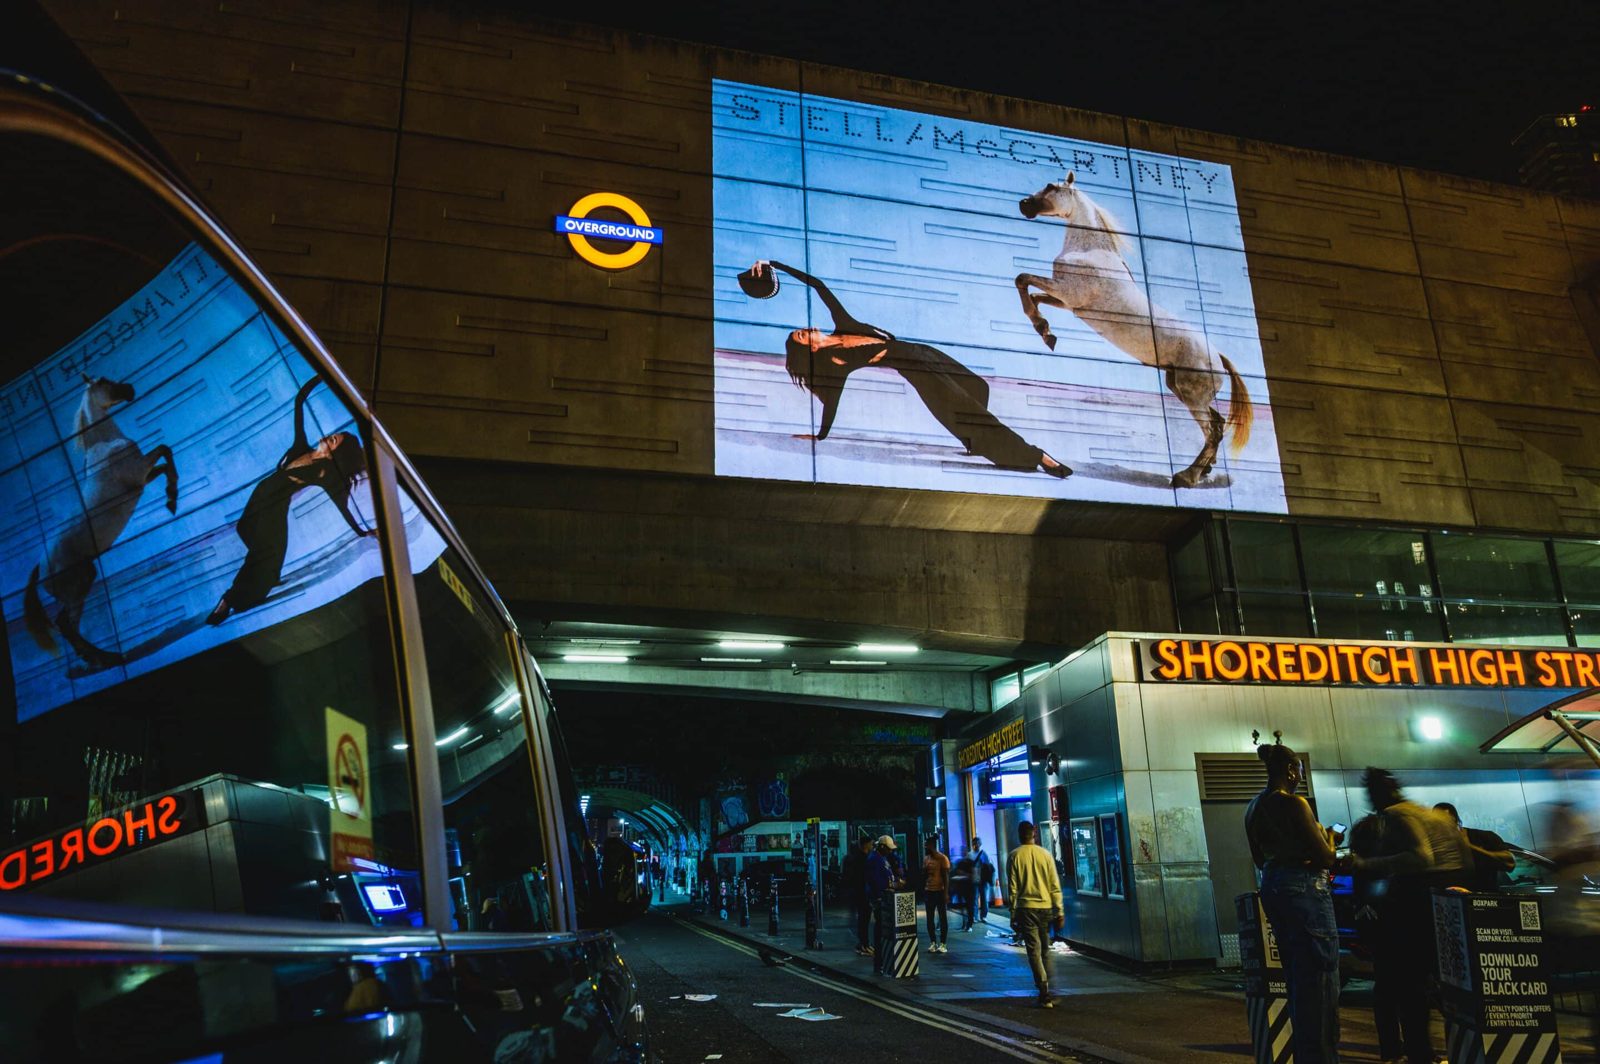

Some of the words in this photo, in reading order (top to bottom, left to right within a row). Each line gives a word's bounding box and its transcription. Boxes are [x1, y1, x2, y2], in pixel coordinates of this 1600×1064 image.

[564, 219, 655, 240] OVERGROUND
[1157, 638, 1420, 685] SHOREDITCH
[1429, 648, 1526, 686] HIGH
[1001, 719, 1025, 751] STREET
[1472, 899, 1498, 908] BOXPARK
[1475, 928, 1491, 936] SCAN
[1479, 953, 1539, 968] DOWNLOAD
[1481, 967, 1513, 981] YOUR
[1482, 981, 1520, 996] BLACK
[1520, 982, 1548, 996] CARD
[1488, 1005, 1511, 1013] LOYALTY
[1511, 1005, 1529, 1013] POINTS
[1534, 1005, 1552, 1013] OFFERS
[1489, 1012, 1510, 1020] EVENTS
[1490, 1019, 1508, 1027] ENTRY
[1508, 1019, 1515, 1027] TO
[1525, 1019, 1539, 1027] SITES
